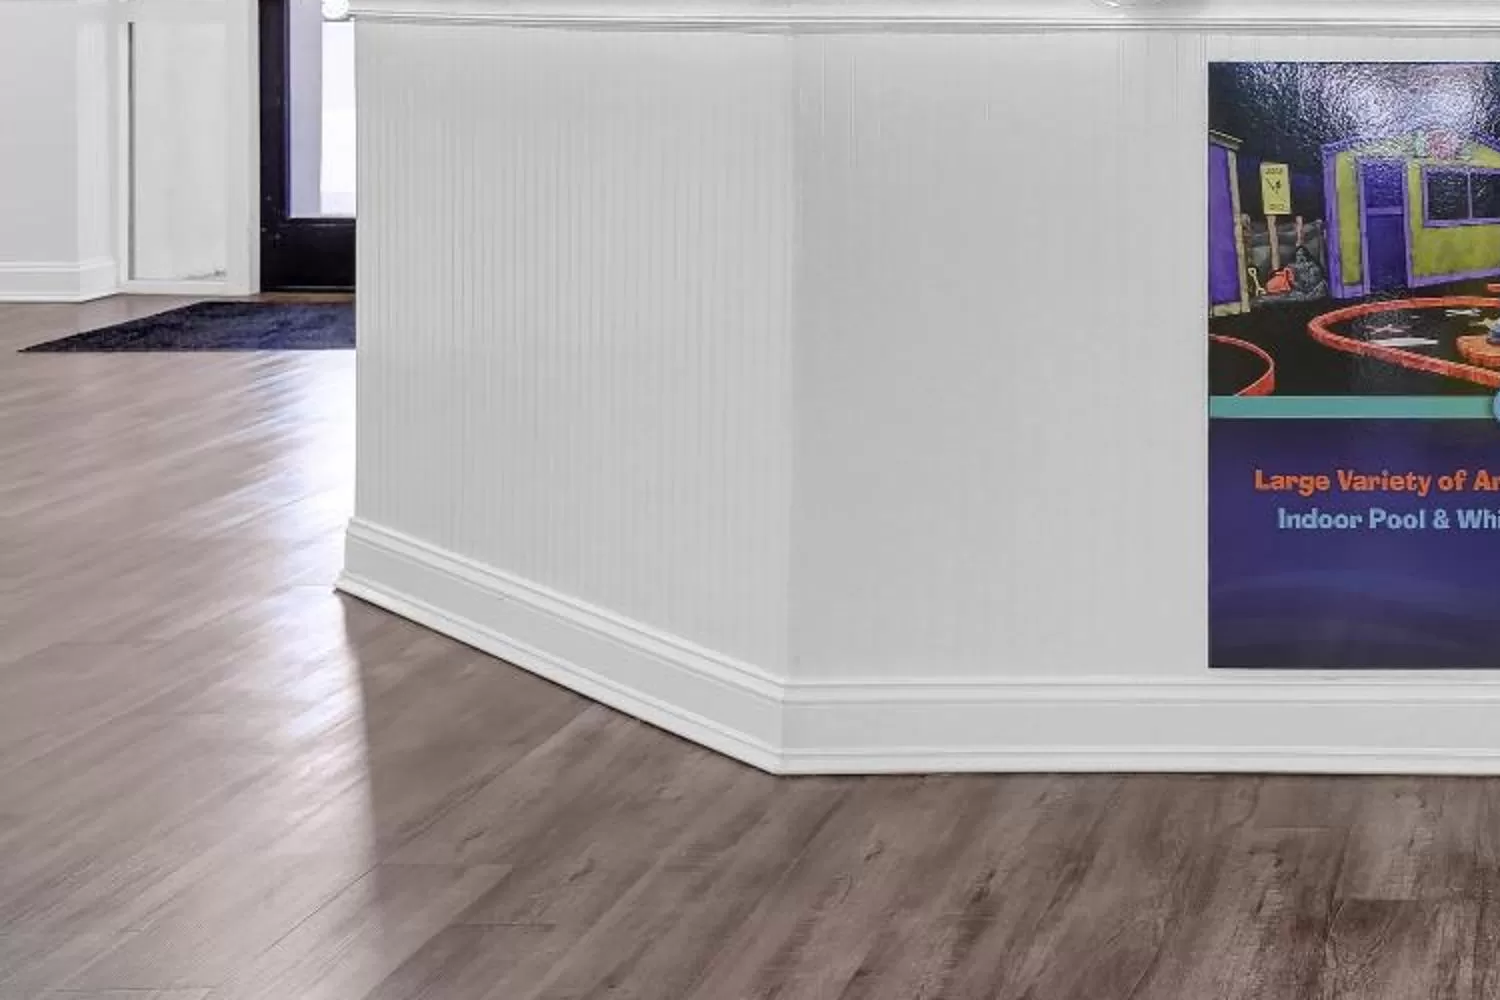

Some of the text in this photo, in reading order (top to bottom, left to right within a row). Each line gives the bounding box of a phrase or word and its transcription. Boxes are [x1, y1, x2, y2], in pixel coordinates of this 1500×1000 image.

[1254, 469, 1330, 495] Large
[1337, 469, 1432, 496] Variety
[1438, 469, 1468, 492] of
[1277, 507, 1363, 530] Indoor
[1368, 507, 1426, 530] Pool
[1432, 507, 1451, 530] &
